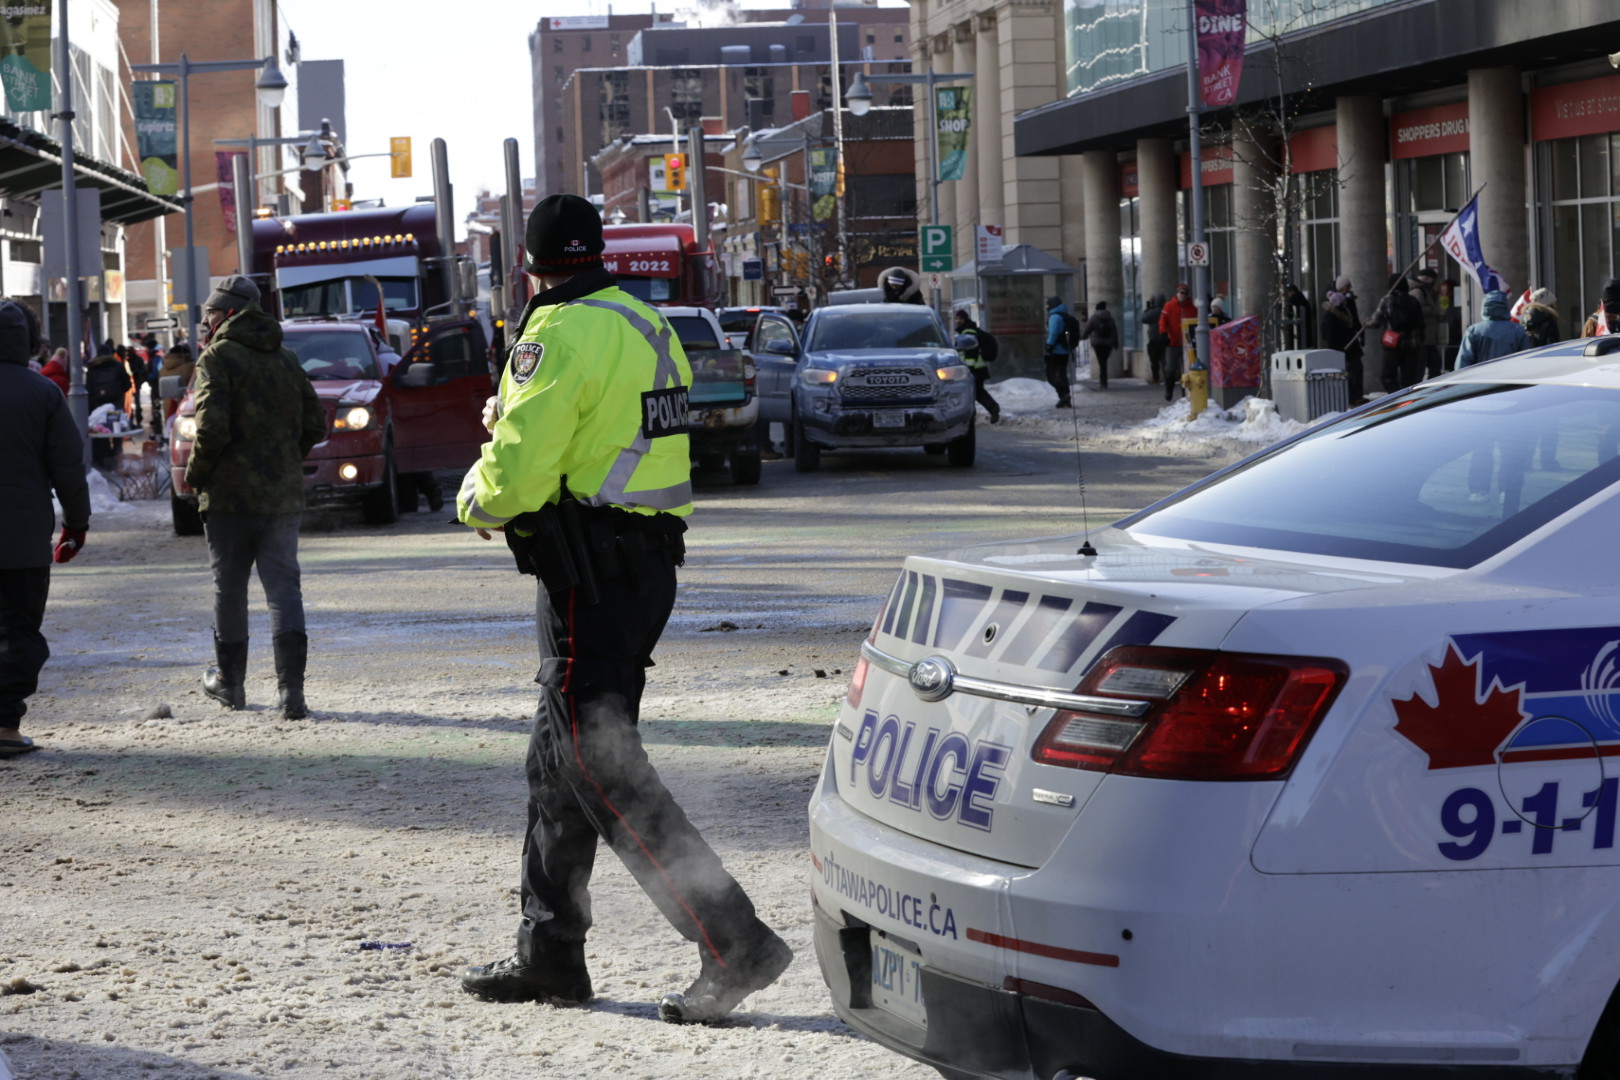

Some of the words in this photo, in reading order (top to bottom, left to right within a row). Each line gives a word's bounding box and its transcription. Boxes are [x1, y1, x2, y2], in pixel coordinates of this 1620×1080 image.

[1200, 14, 1242, 34] DINE
[3, 63, 38, 87] BANK
[1204, 64, 1231, 85] BANK
[1204, 76, 1233, 94] STREET
[939, 119, 968, 132] SHOP
[1397, 123, 1441, 143] SHOPPERS
[1441, 119, 1464, 137] DRUG
[927, 229, 946, 254] P
[629, 260, 670, 272] 2022
[516, 344, 541, 355] POLICE
[869, 374, 908, 384] TOYOTA
[911, 664, 937, 687] Ford
[851, 708, 1013, 833] POLICE
[823, 855, 958, 941] OTTAWAPOLICE.CA
